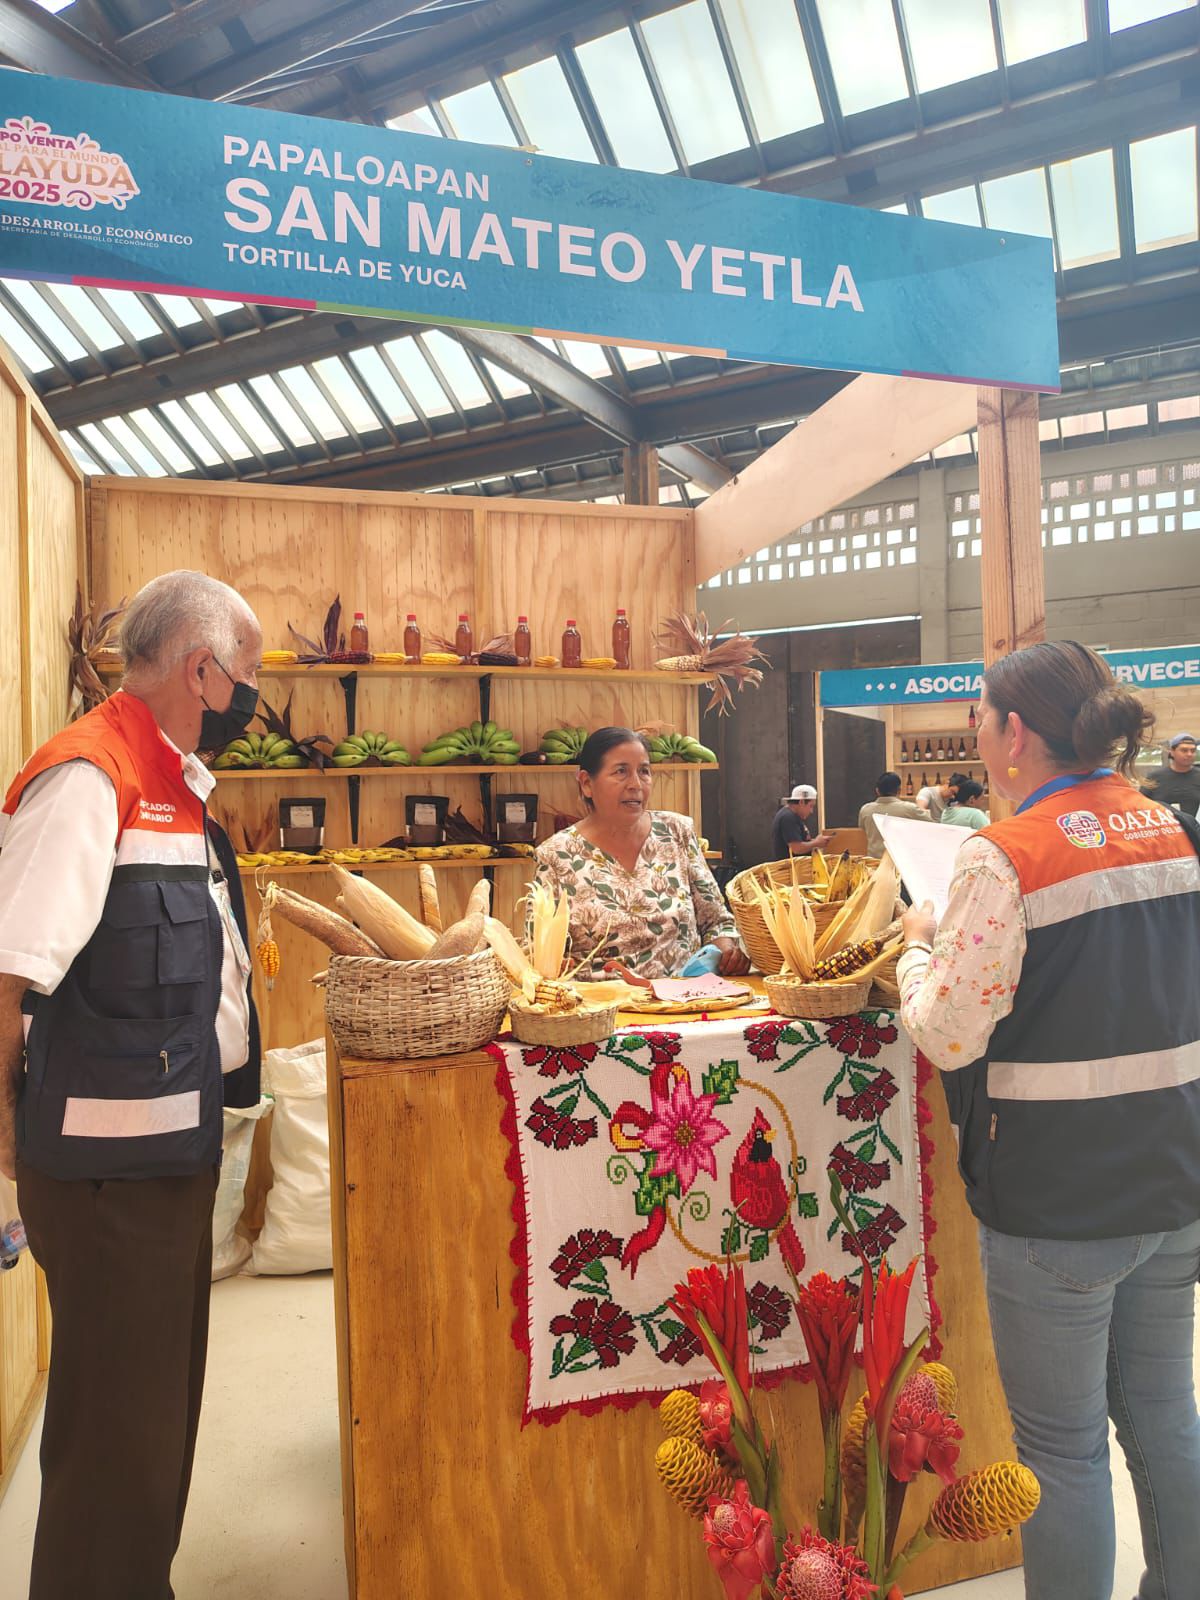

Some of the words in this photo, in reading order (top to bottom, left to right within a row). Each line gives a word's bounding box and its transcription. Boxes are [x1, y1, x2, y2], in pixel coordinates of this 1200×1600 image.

[26, 133, 76, 150] VENTA
[15, 144, 49, 158] PARA
[53, 149, 66, 159] EL
[70, 151, 120, 166] MUNDO
[223, 135, 489, 202] PAPALOAPAN
[0, 177, 61, 203] 2025
[1, 214, 102, 235] DESARROLLO
[106, 226, 193, 246] ECONÓMICO
[50, 230, 60, 238] DE
[63, 232, 112, 243] DESARROLLO
[223, 177, 381, 248] SAN
[407, 200, 648, 283] MATEO
[665, 239, 865, 313] YETLA
[223, 242, 352, 276] TORTILLA
[359, 258, 392, 281] DE
[399, 263, 467, 290] YUCA
[1123, 829, 1160, 841] GOBIERNO
